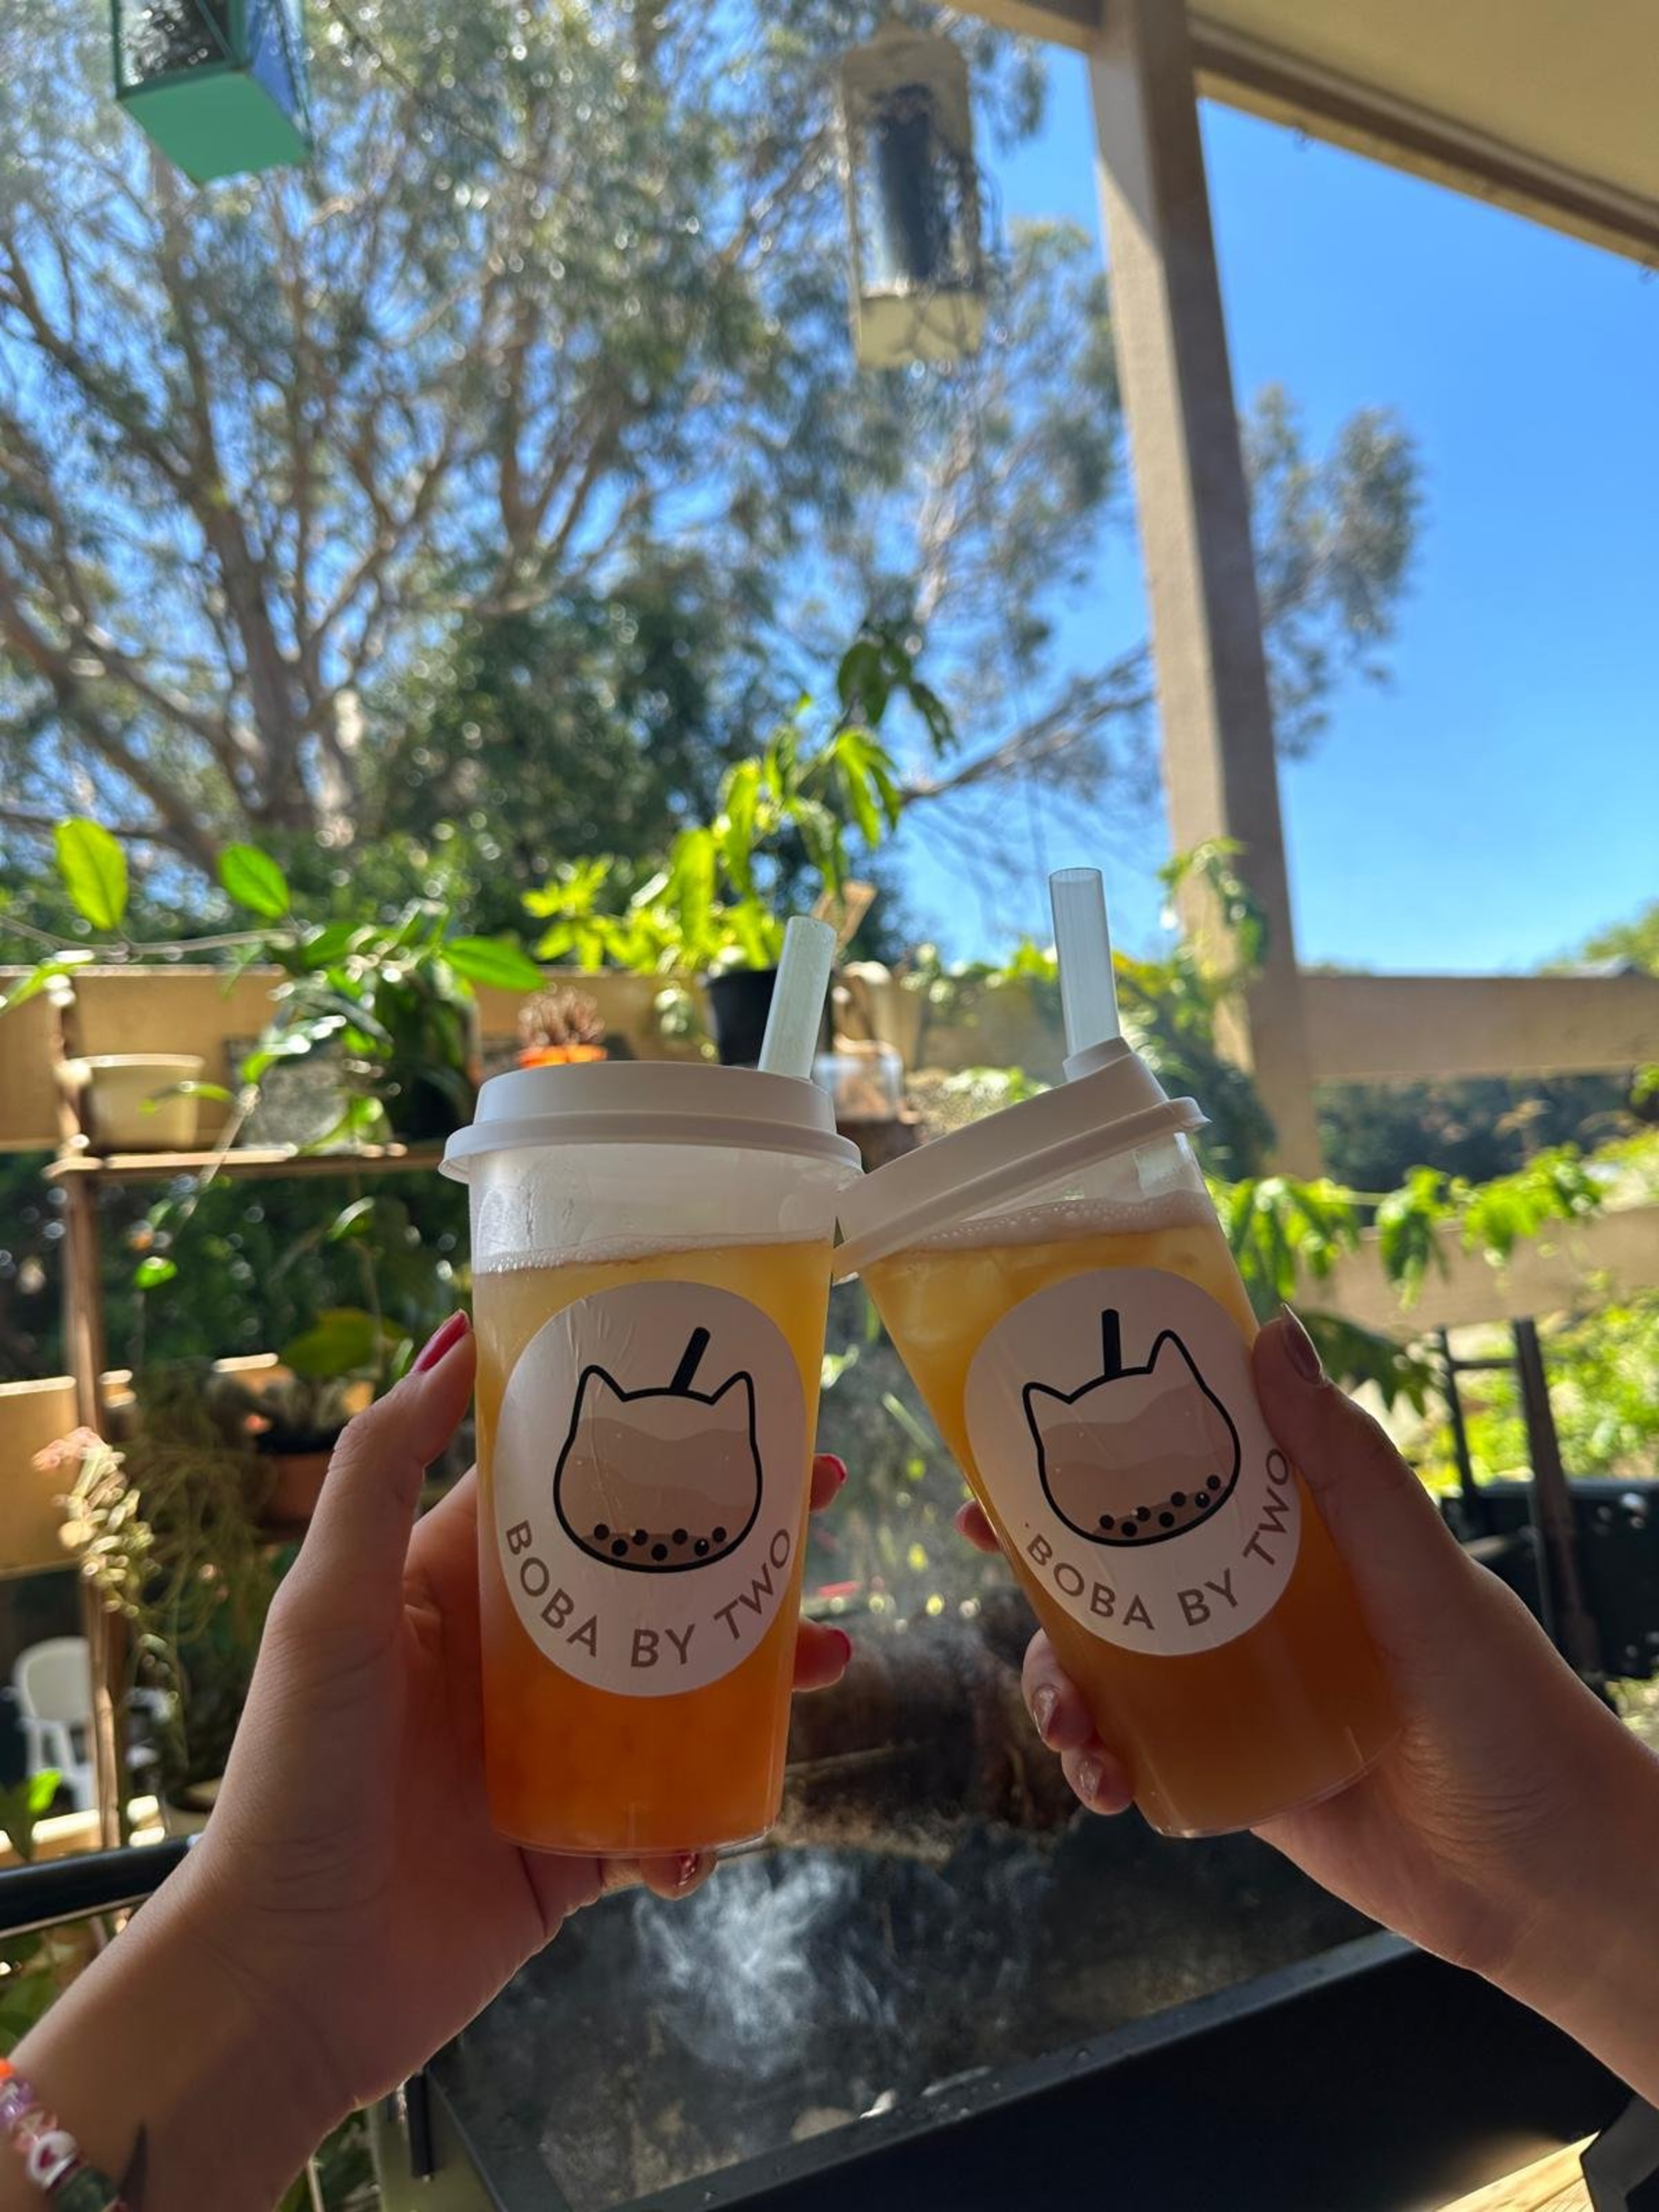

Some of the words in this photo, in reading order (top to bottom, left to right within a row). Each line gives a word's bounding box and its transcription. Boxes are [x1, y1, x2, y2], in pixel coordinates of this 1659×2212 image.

[506, 1520, 598, 1658] BOBA
[630, 1624, 695, 1667] BY
[713, 1529, 791, 1640] TWO
[1026, 1534, 1156, 1631] BOBA
[1177, 1568, 1239, 1627] BY
[1243, 1449, 1291, 1566] TWO
